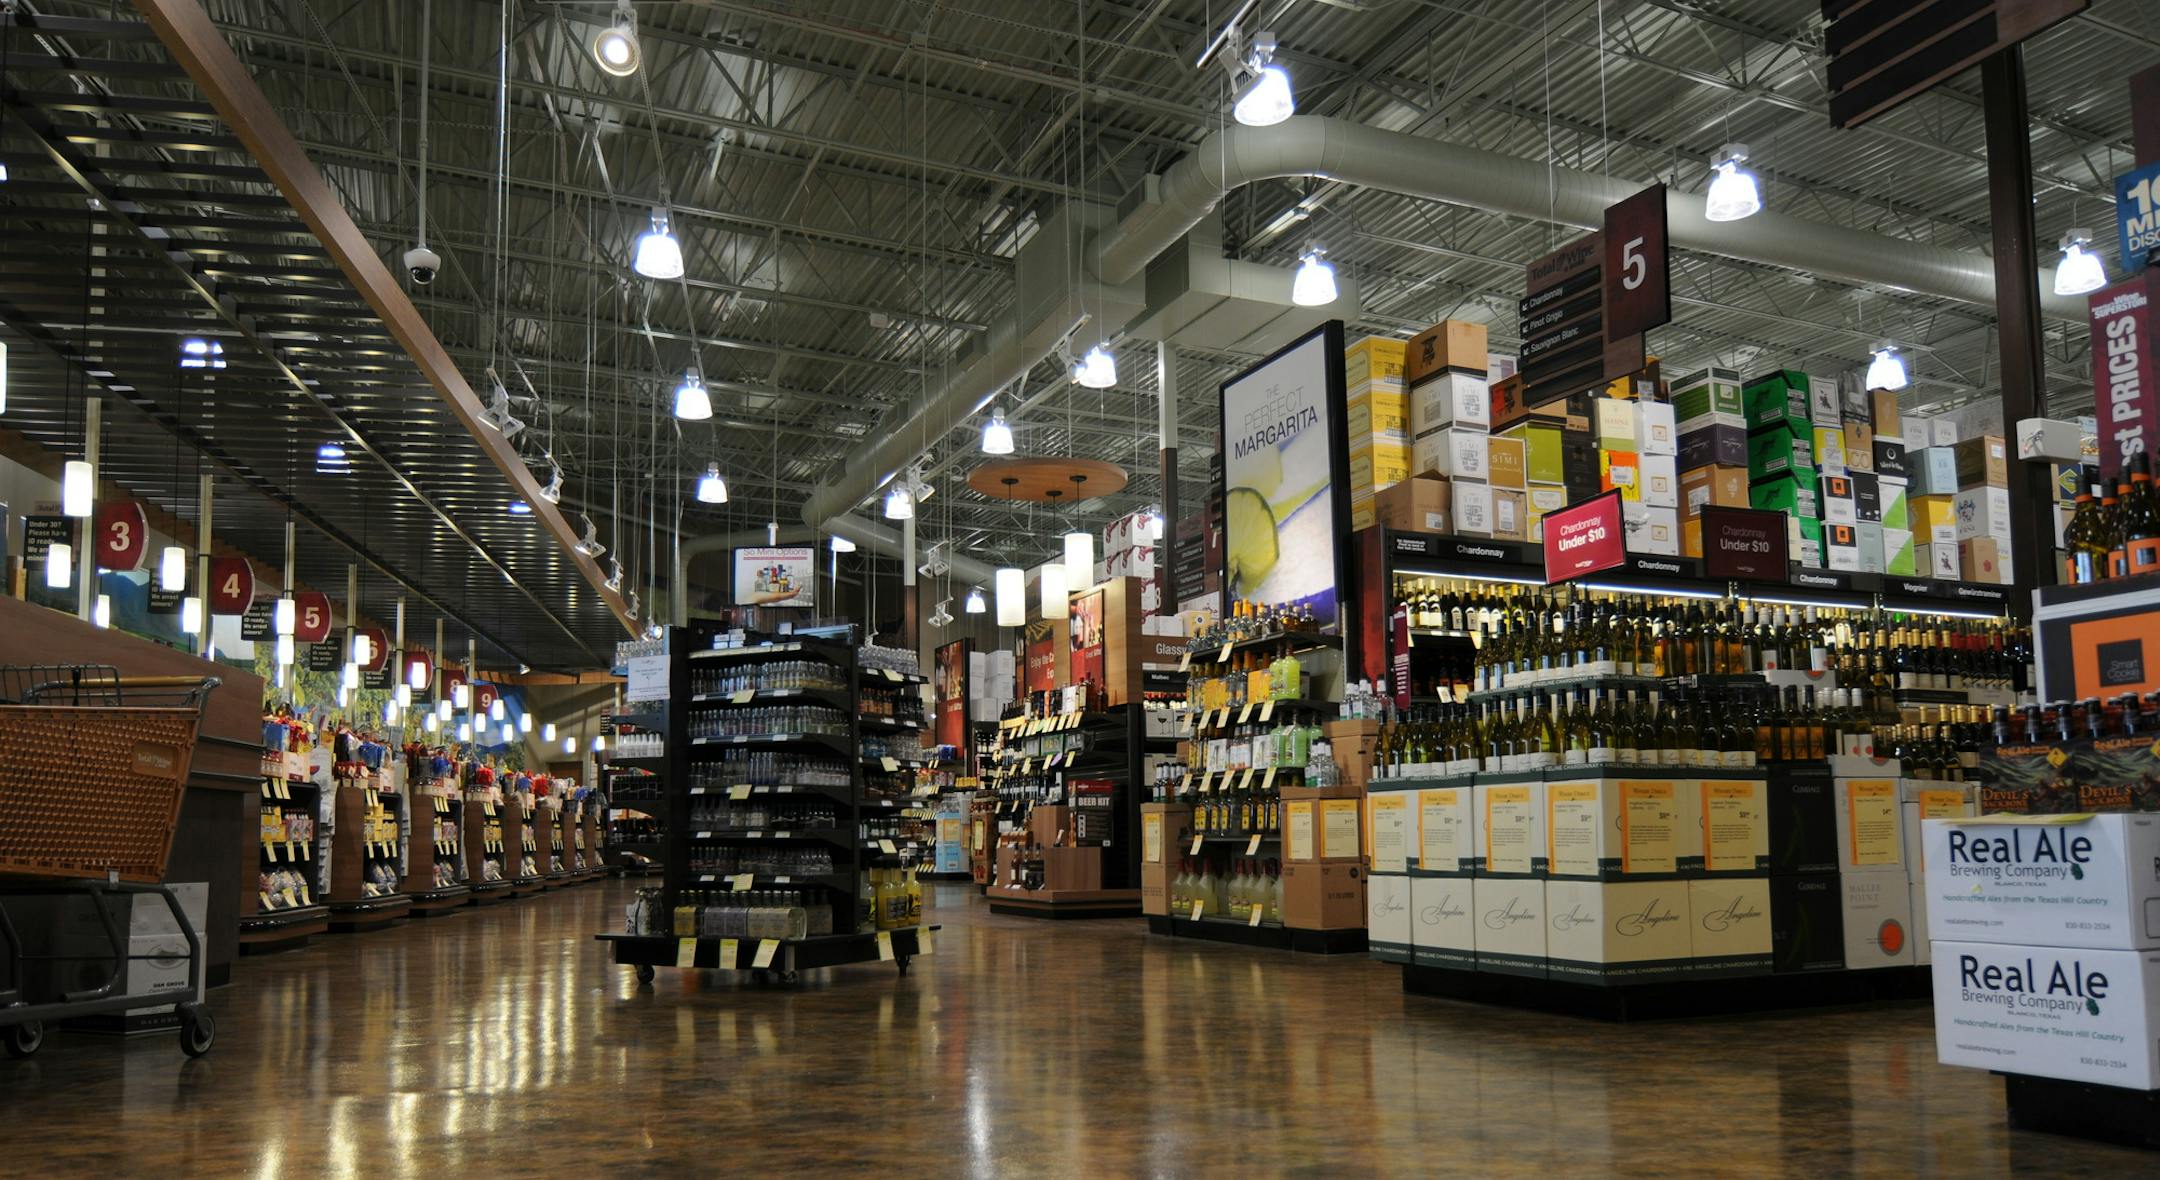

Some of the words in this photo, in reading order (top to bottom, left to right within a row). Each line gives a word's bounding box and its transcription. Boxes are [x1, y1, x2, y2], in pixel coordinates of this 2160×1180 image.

[1622, 236, 1646, 290] 5
[1529, 287, 1564, 308] Chardonnay
[1529, 317, 1545, 330] Pinot
[1545, 310, 1563, 323] Grigio
[1530, 334, 1561, 353] Sauvignon
[1561, 326, 1579, 341] Blanc
[2105, 315, 2143, 422] PRICES
[1265, 384, 1280, 399] THE
[1244, 385, 1304, 433] PERFECT
[1234, 405, 1318, 460] MARGARITA
[1492, 455, 1518, 465] SIMI
[110, 521, 130, 552] 3
[1560, 516, 1601, 536] Chardonnay
[1722, 525, 1767, 538] Chardonnay
[1558, 534, 1587, 552] Under
[1587, 527, 1606, 543] $10
[1719, 538, 1749, 551] Under
[1752, 540, 1770, 553] $10
[776, 548, 808, 557] Options
[1456, 545, 1505, 558] Chardonnay
[1638, 560, 1680, 573] Chardonnay
[222, 573, 241, 598] 4
[1799, 574, 1838, 586] Chardonnay
[1903, 582, 1928, 593] Viognier
[304, 606, 321, 629] 5
[1151, 673, 1170, 681] Malbec
[481, 693, 492, 708] 9
[1078, 797, 1097, 806] BEER
[1097, 797, 1110, 806] KIT
[1948, 828, 2022, 863] Real
[2033, 826, 2093, 864] Ale
[1949, 864, 2002, 880] Brewing
[2004, 864, 2069, 880] Company
[1420, 894, 1465, 926] Angeline
[2003, 895, 2021, 905] from
[2023, 895, 2036, 903] the
[2037, 896, 2059, 904] Texas
[2060, 896, 2075, 904] Hill
[2076, 896, 2108, 907] Country
[1483, 896, 1536, 930] Angeline
[1552, 903, 1596, 932] Angeline
[1615, 898, 1680, 937] Angeline
[1702, 895, 1763, 933] Angeline
[1959, 954, 2036, 993] Real
[2046, 960, 2109, 999] Ale
[1961, 989, 2014, 1009] Brewing
[2018, 993, 2083, 1014] Company
[1953, 1017, 1998, 1030] Handcrafted
[1999, 1022, 2015, 1031] Ales
[2015, 1023, 2035, 1034] from
[2036, 1025, 2049, 1034] the
[2051, 1026, 2074, 1037] Texas
[2075, 1029, 2090, 1038] Hill
[2091, 1031, 2125, 1043] Country
